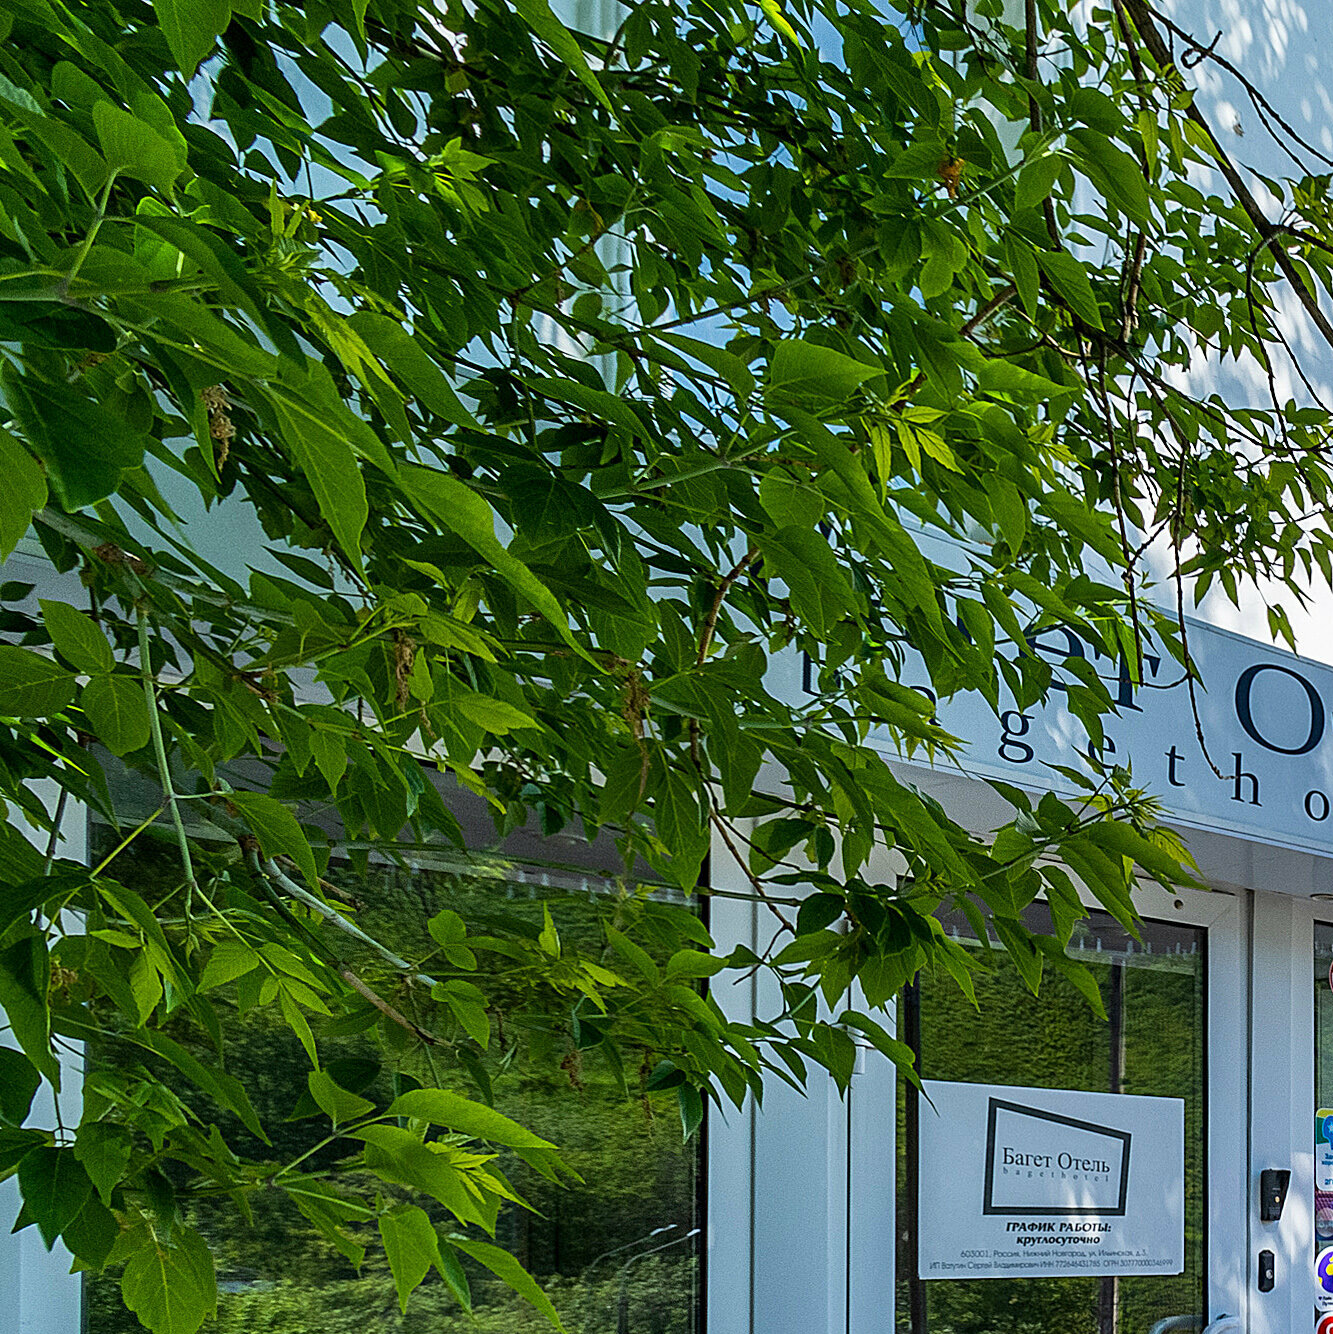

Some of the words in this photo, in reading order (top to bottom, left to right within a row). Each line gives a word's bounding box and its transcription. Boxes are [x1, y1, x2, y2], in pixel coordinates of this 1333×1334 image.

[1003, 1147, 1053, 1168] Багет
[1058, 1152, 1111, 1173] Отель
[1003, 1167, 1109, 1182] bagethotel
[1006, 1222, 1056, 1232] ГРАФИК
[1059, 1222, 1112, 1232] РАБОТЫ:
[1016, 1236, 1100, 1247] круглосуточно
